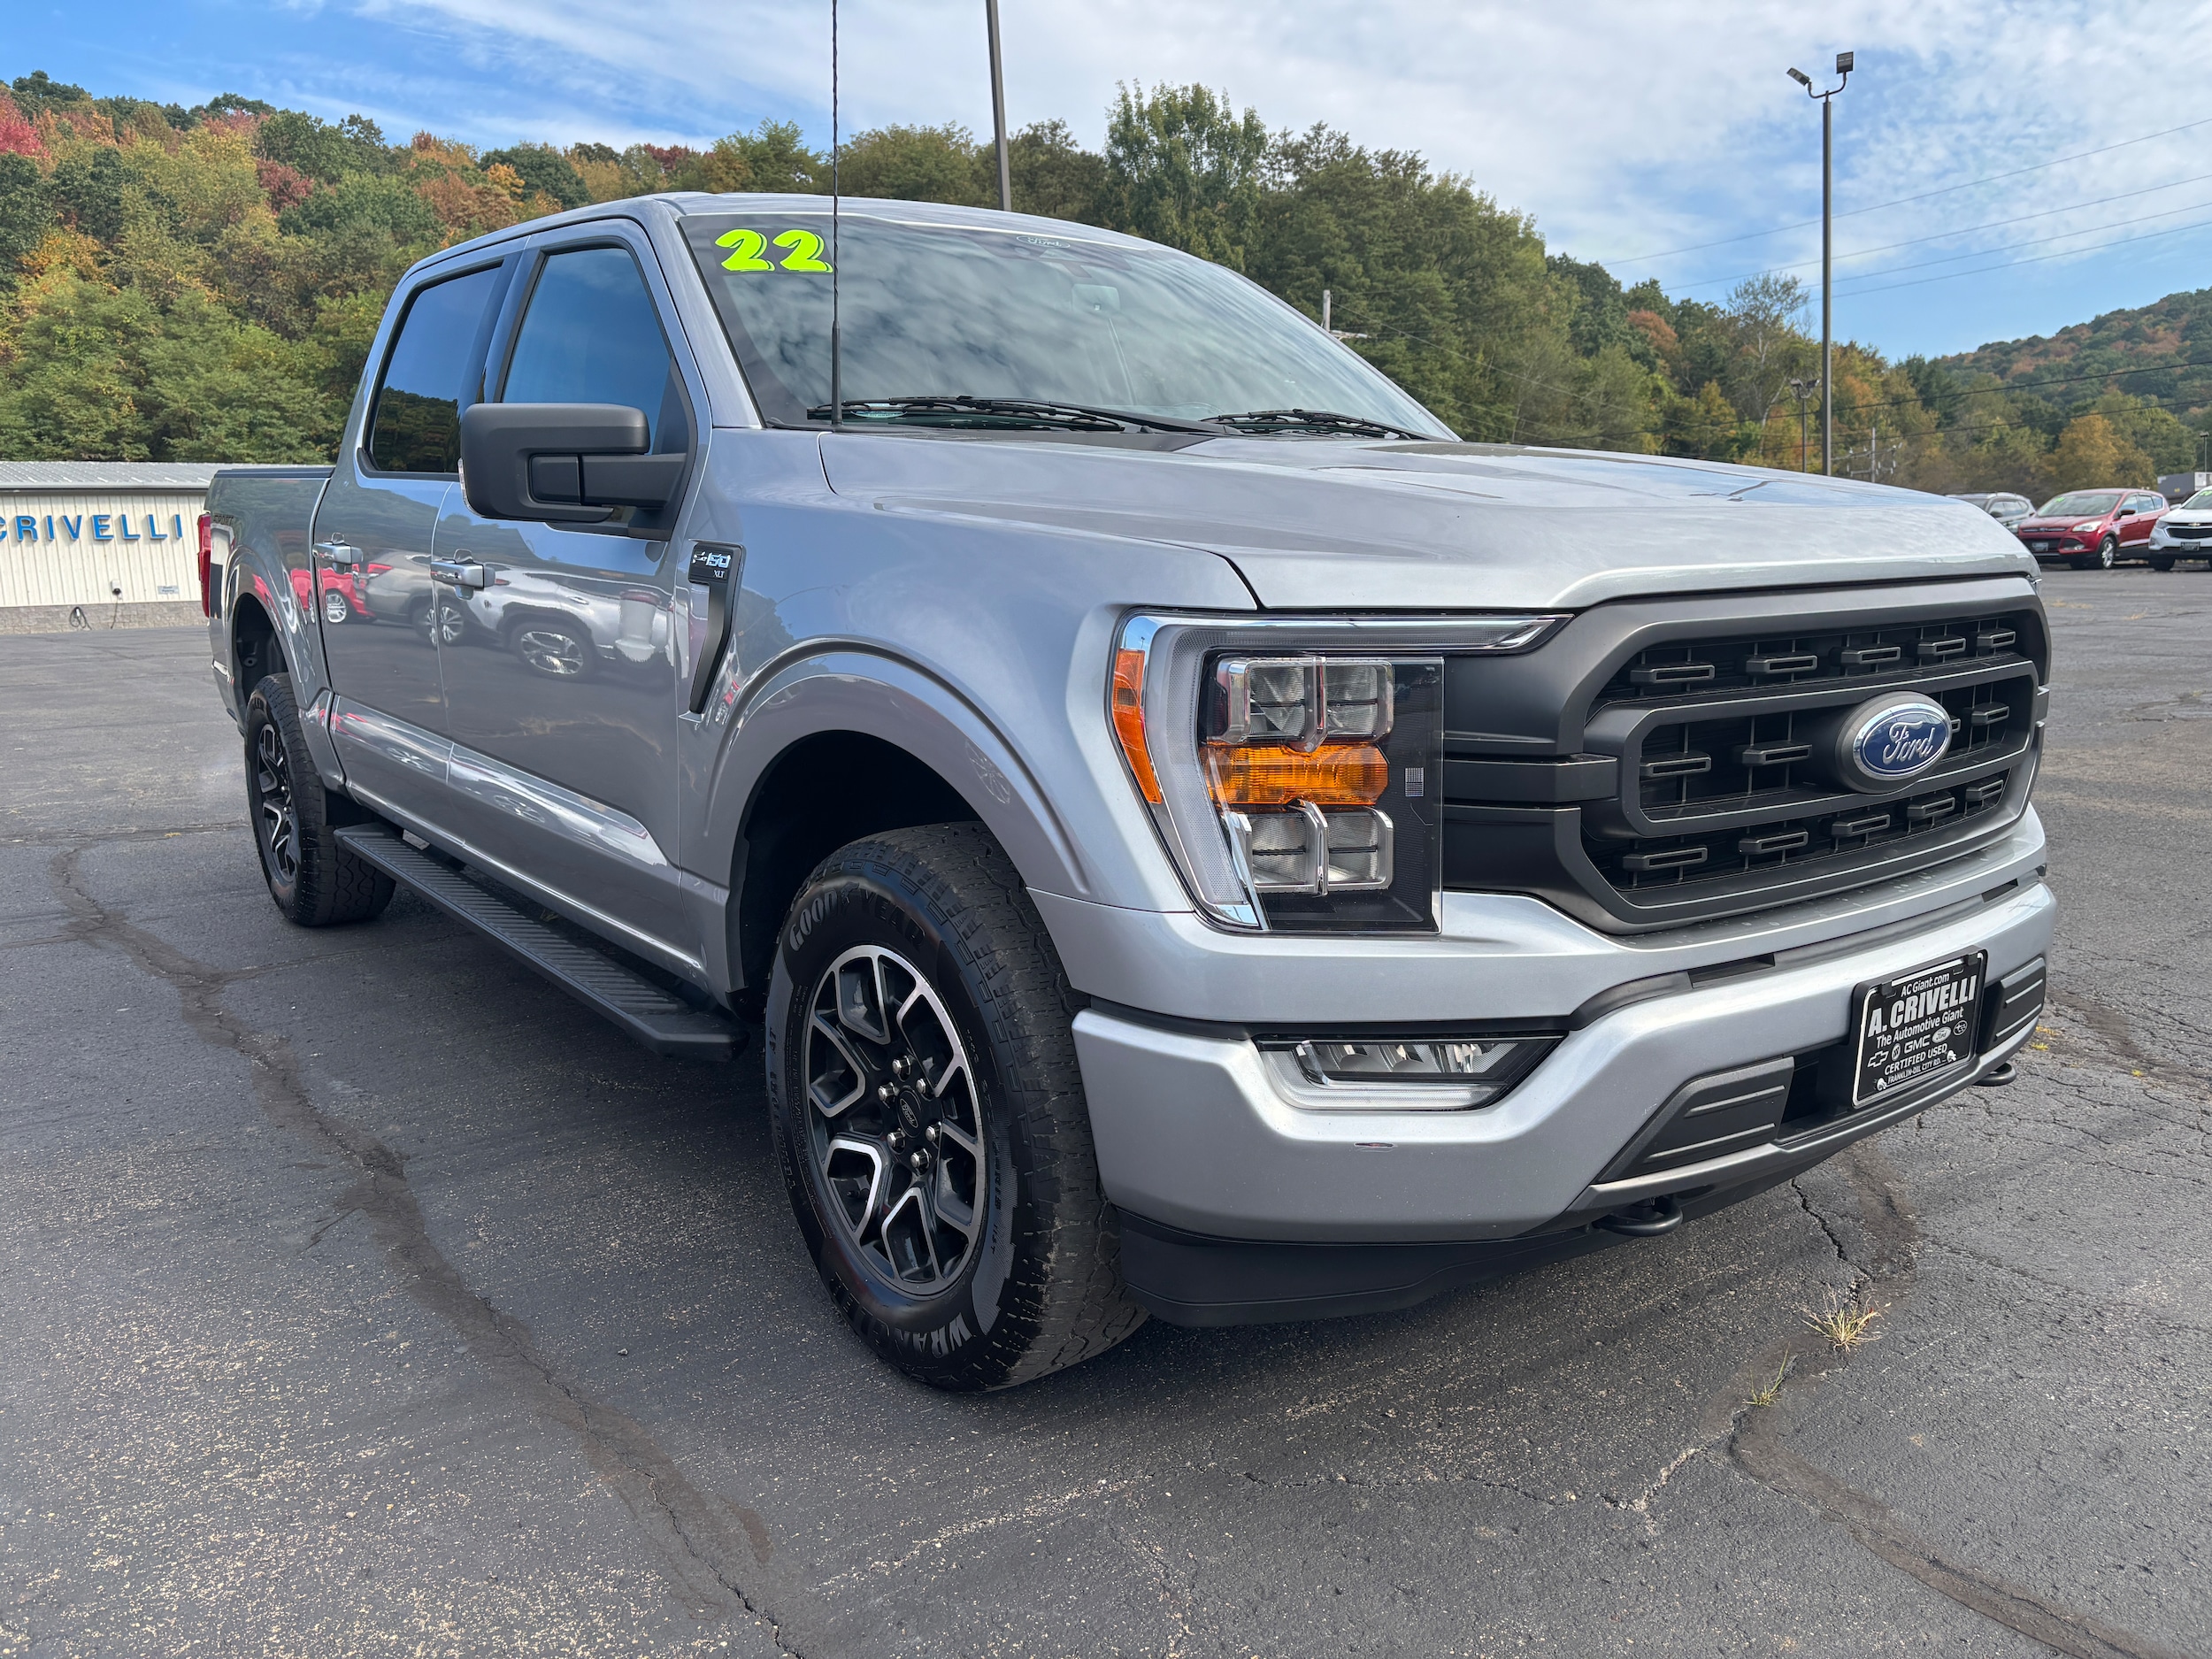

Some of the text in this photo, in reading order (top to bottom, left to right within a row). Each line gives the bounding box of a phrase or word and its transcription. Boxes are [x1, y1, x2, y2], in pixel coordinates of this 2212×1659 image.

[714, 228, 833, 273] 22
[1882, 720, 1936, 764] Ford
[1867, 974, 1978, 1038] A. CRIVELLI
[1877, 1006, 1964, 1048] The Automotive Giant
[1885, 1043, 1947, 1075] CERTIFIED USED
[1904, 1034, 1931, 1054] GMC
[1922, 1060, 1933, 1070] CITY
